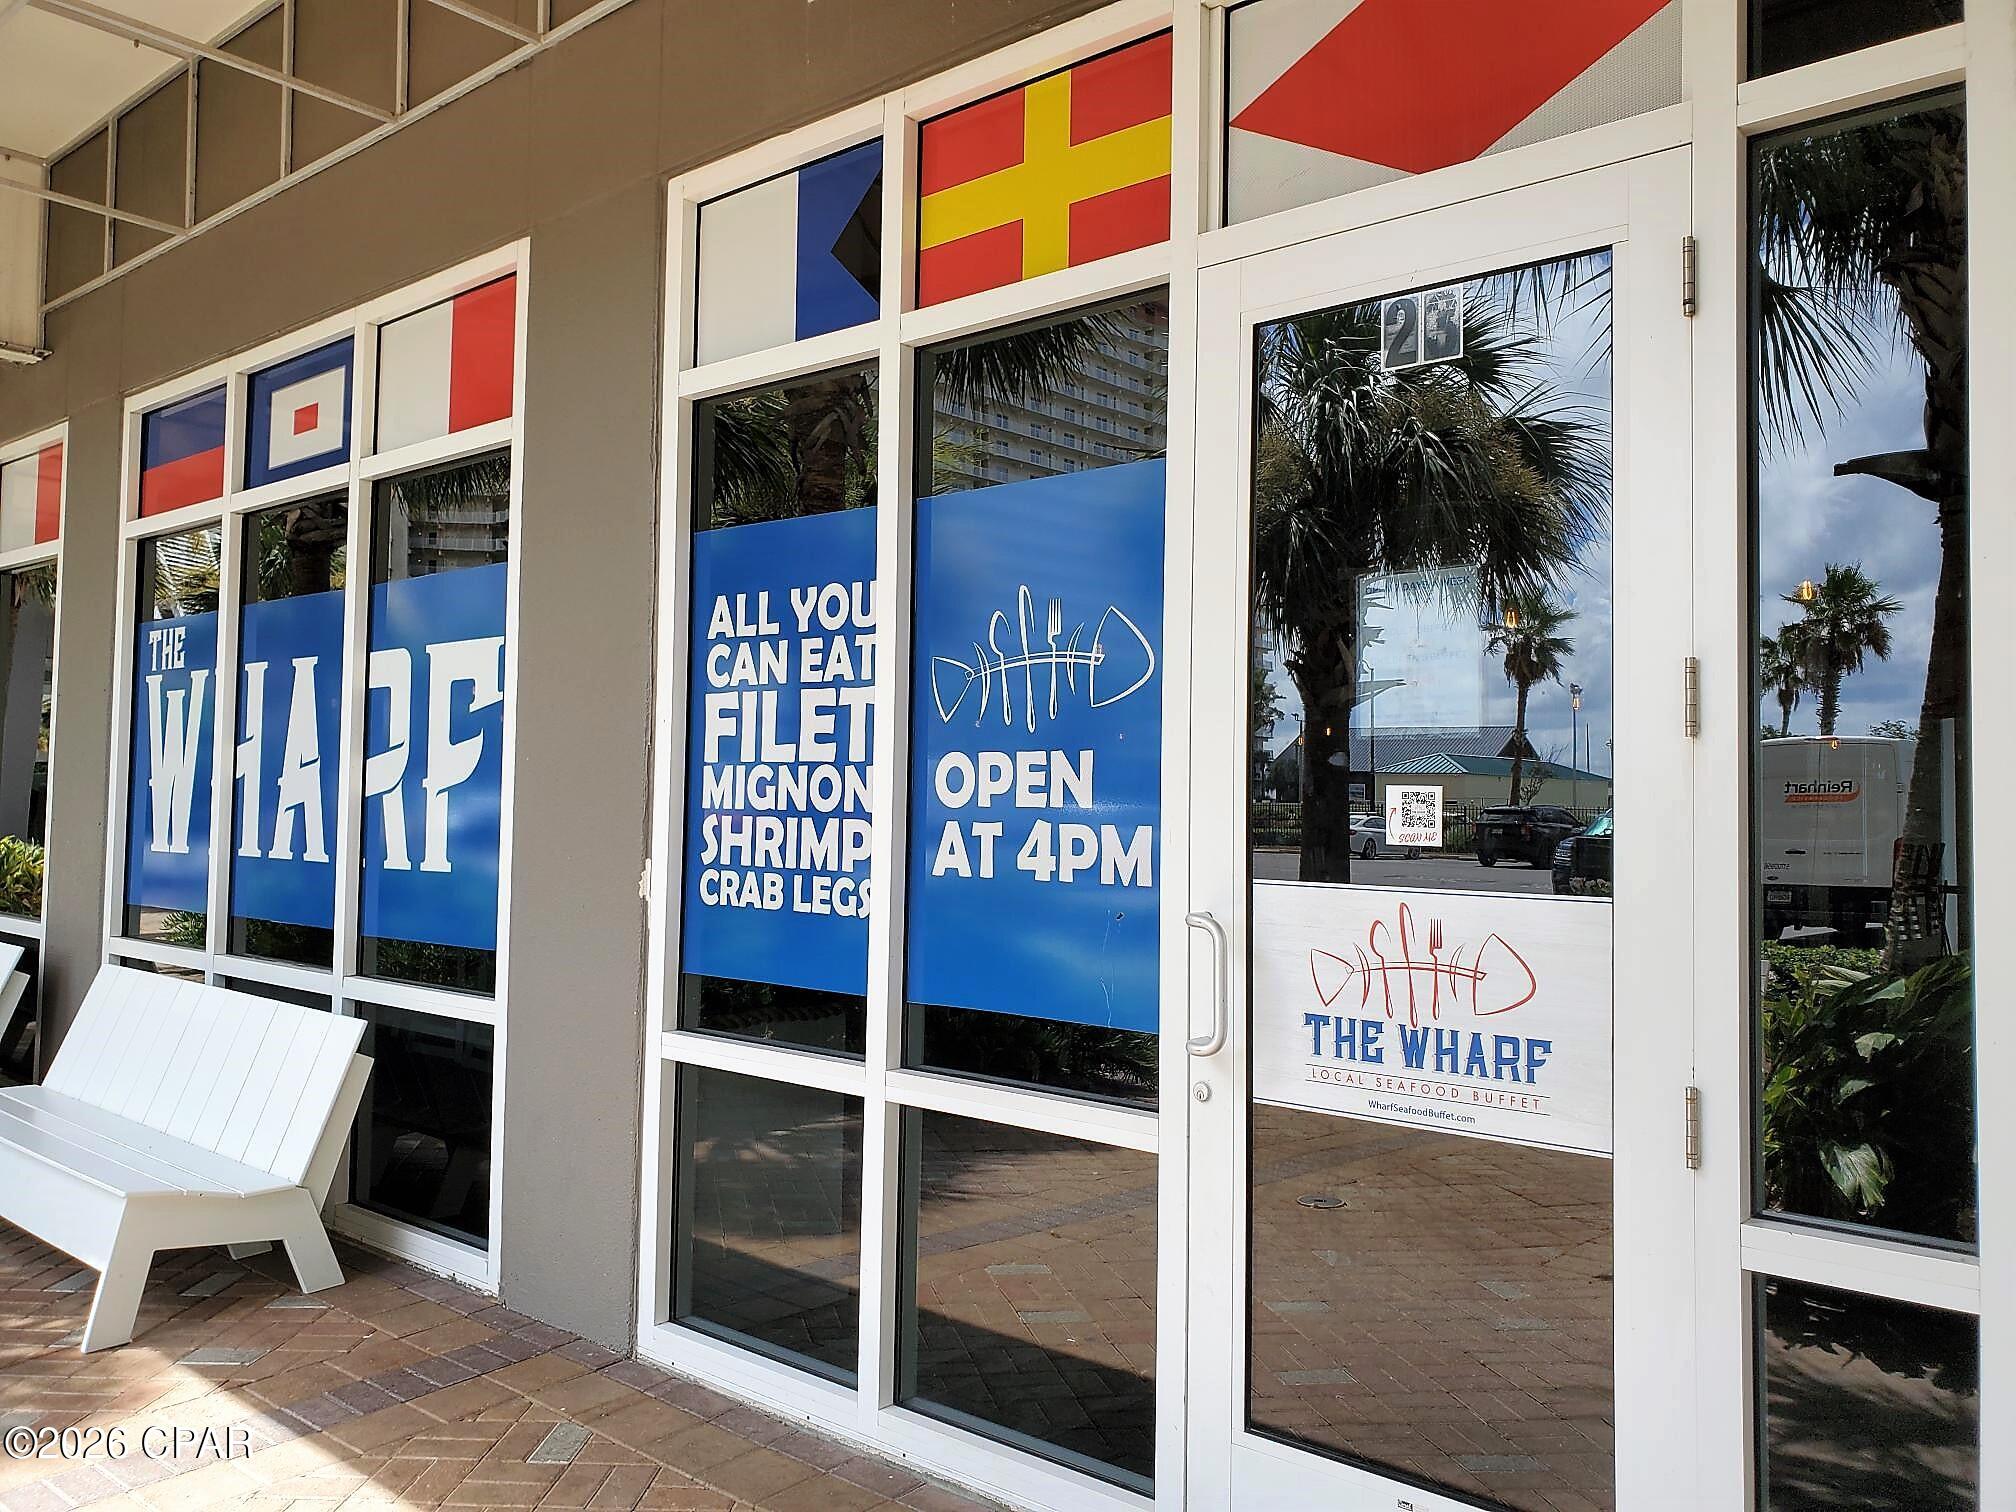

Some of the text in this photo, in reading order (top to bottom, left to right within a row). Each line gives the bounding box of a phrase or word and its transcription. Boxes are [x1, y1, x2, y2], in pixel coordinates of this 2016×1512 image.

[707, 580, 876, 640] ALL YOU
[148, 626, 186, 671] THE
[706, 633, 876, 688] CAN EAT
[703, 686, 876, 763] FILET
[146, 636, 505, 873] WHARF
[934, 749, 1094, 809] OPEN
[702, 763, 874, 814] MIGNON
[700, 814, 873, 872] SHRIMP
[931, 818, 1153, 887] AT 4PM
[1423, 831, 1438, 842] ME
[699, 868, 872, 919] CRAB LEGS
[1303, 1012, 1553, 1085] THE WHARF
[1312, 1067, 1540, 1110] LOCAL SEAFOOD BUFFET
[1368, 1099, 1476, 1125] WharfSeafoodBuffet.com
